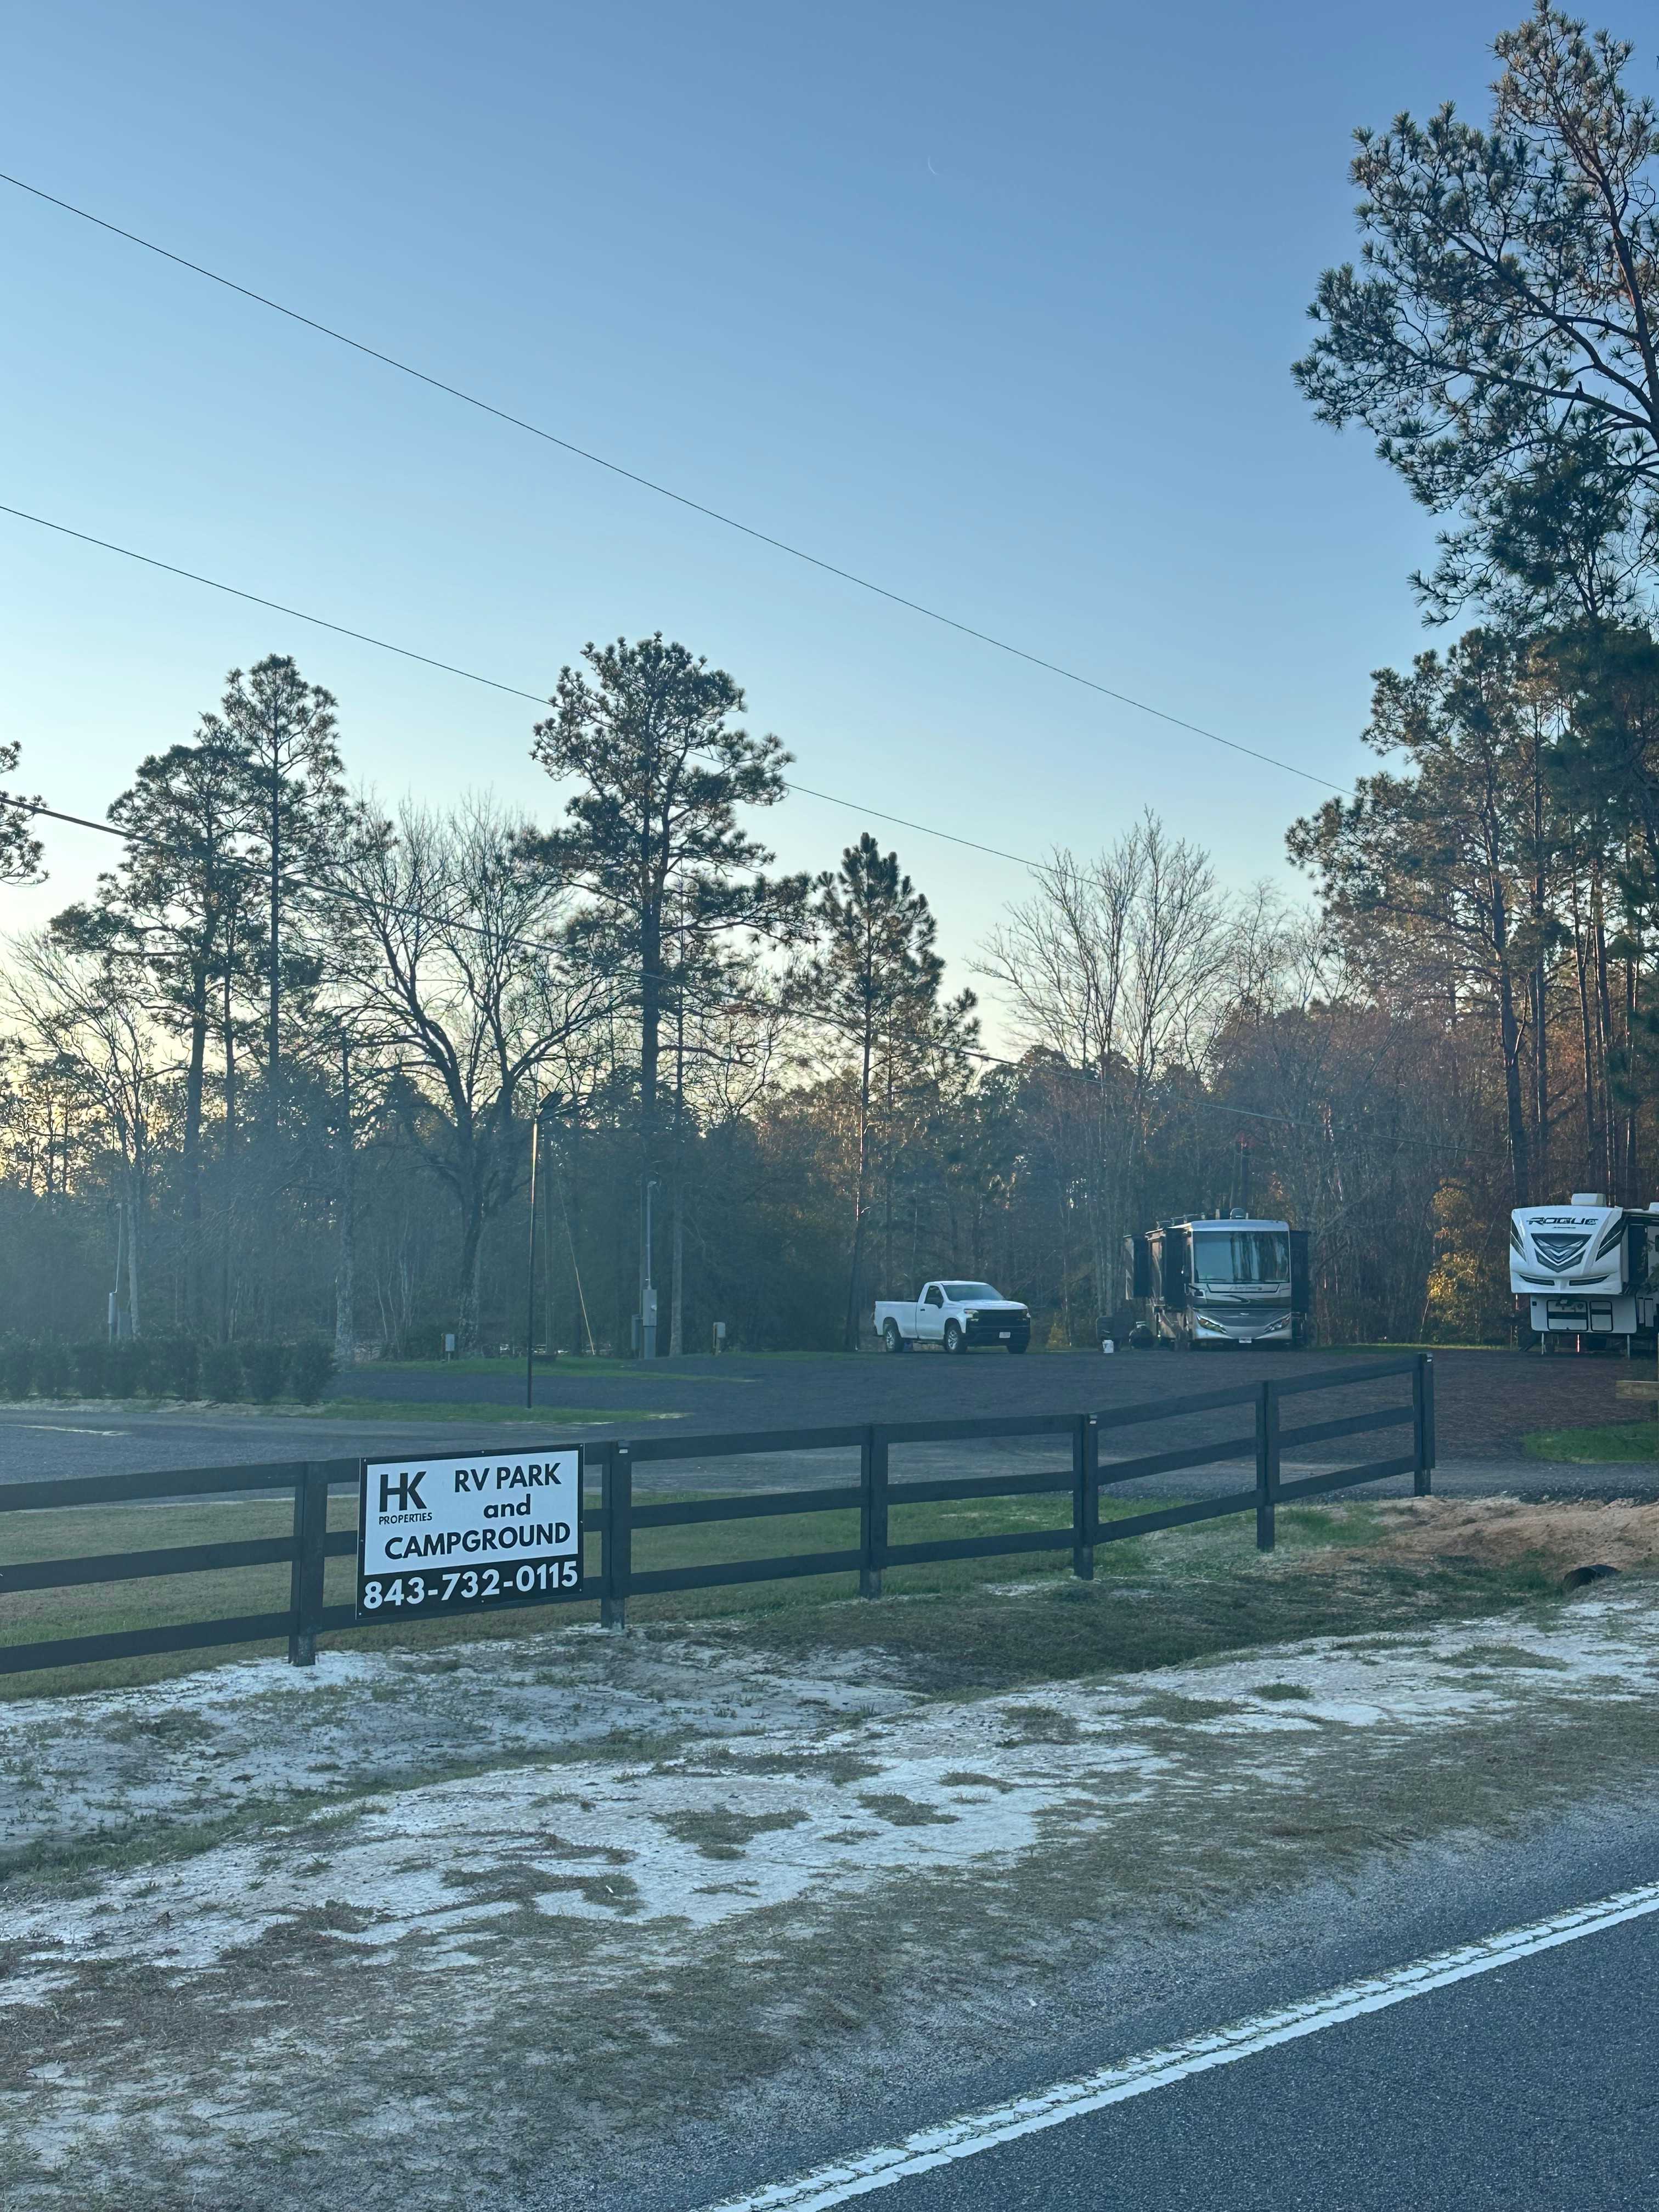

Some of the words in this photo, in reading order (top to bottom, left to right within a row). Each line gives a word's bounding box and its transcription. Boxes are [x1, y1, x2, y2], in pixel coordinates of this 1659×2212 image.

[379, 1471, 427, 1513] HK
[454, 1468, 490, 1493] RV
[496, 1463, 562, 1489] PARK
[379, 1512, 432, 1525] PROPERTIES
[483, 1493, 531, 1519] and
[384, 1522, 571, 1560] CAMPGROUND
[363, 1561, 578, 1610] 843-732-0115
